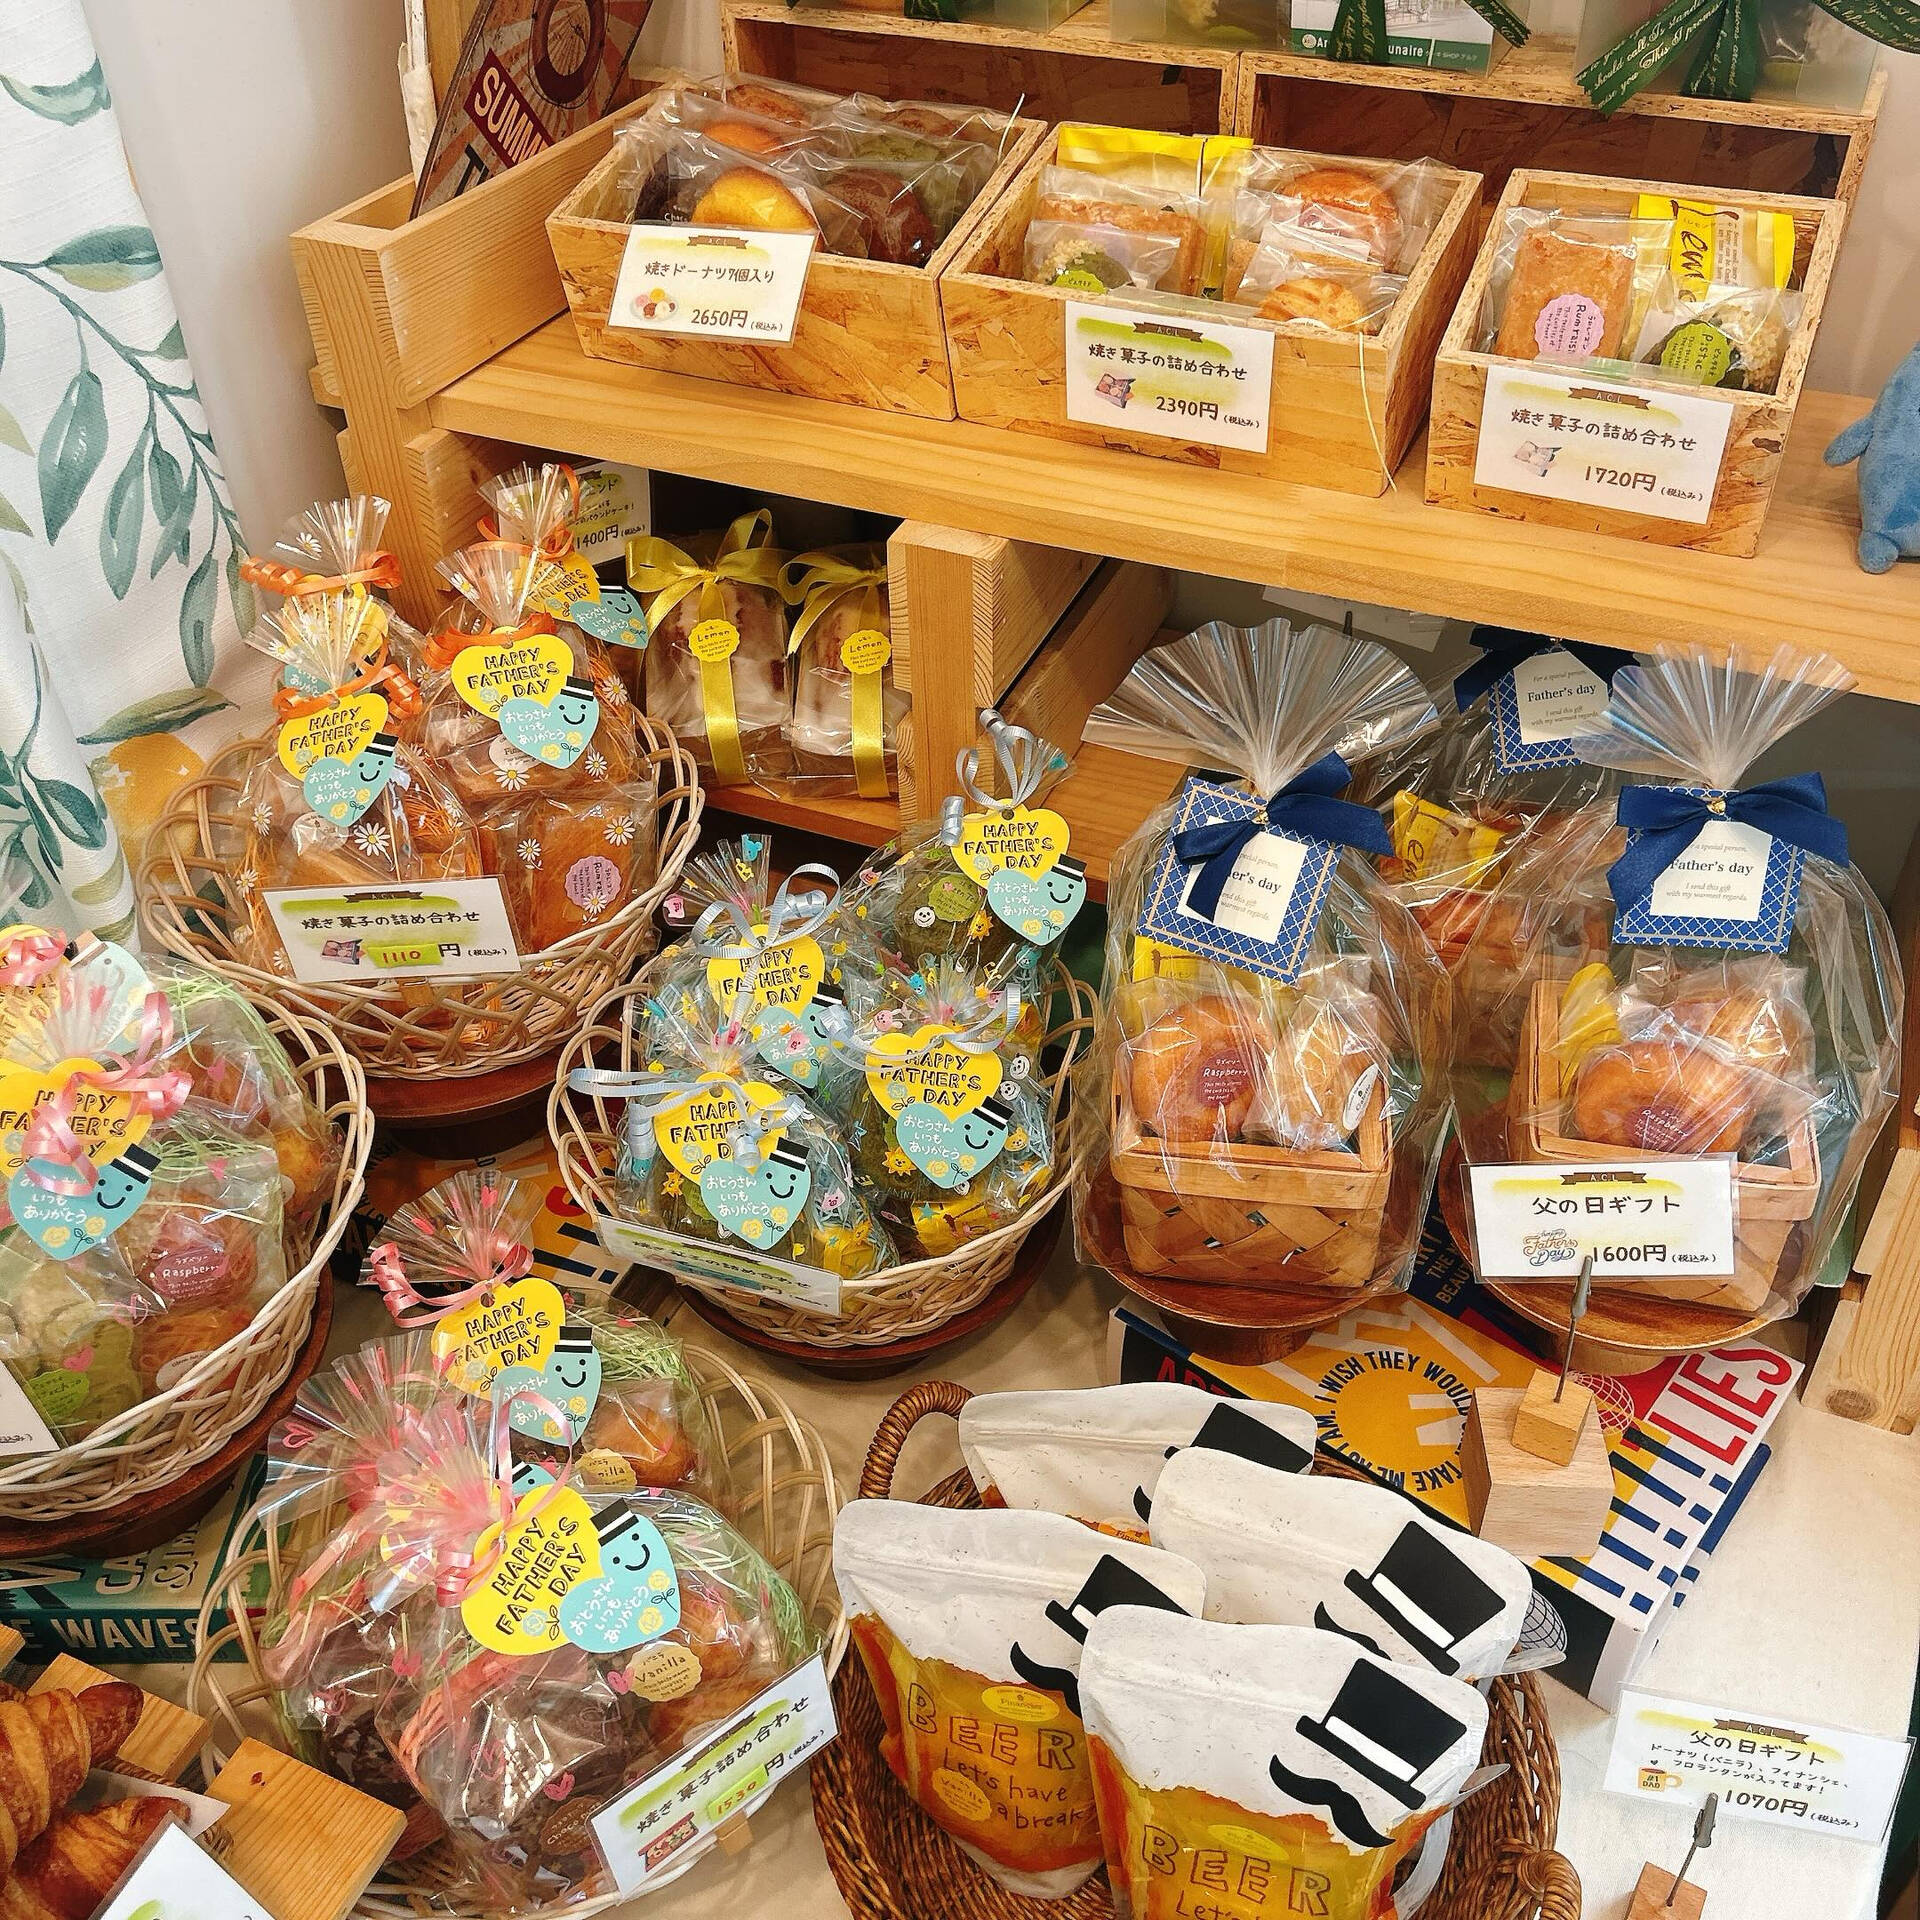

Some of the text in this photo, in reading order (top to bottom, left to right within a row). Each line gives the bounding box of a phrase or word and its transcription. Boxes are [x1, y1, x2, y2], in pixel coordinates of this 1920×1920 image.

[1388, 44, 1424, 57] unaire
[644, 260, 775, 284] 焼きドーナツ7個入り
[690, 308, 749, 328] 2650円
[1088, 343, 1248, 380] 焼き菓子の詰め合わせ
[1155, 396, 1219, 421] 2390円
[1511, 408, 1697, 451] 焼き菓子の詰め合わせ
[1584, 465, 1657, 493] 1720円
[565, 583, 591, 602] DAY
[697, 629, 730, 642] Lemon
[484, 648, 540, 669] HAPPY
[467, 661, 560, 689] FATHER'S
[512, 679, 550, 697] DAY
[1527, 684, 1597, 703] Father's day
[309, 706, 361, 731] HAPPY
[505, 709, 551, 724] おとうさん
[290, 719, 371, 751] FATHER'S
[517, 729, 565, 745] ありがとう
[325, 737, 359, 757] DAY
[309, 768, 351, 784] おとうさん
[314, 787, 357, 805] ありがとう
[983, 822, 1039, 837] HAPPY
[964, 837, 1054, 855] FATHER'S
[1005, 853, 1043, 869] DAY
[1670, 859, 1754, 876] Father's day
[993, 882, 1039, 893] おとうさん
[1258, 878, 1281, 894] day
[302, 910, 481, 930] 焼き菓子の詰め合わせ
[1002, 905, 1049, 917] ありがとう
[382, 949, 422, 964] 1110
[438, 942, 462, 958] 円
[739, 948, 793, 972] HPPY
[766, 985, 802, 1006] DAY
[923, 1088, 967, 1106] DAY
[0, 1110, 126, 1137] FAER'S
[903, 1114, 954, 1132] おとうさん
[909, 1140, 960, 1160] ありがとう
[706, 1176, 757, 1190] おとうさん
[1589, 1173, 1619, 1183] ACL
[23, 1205, 88, 1225] ありがとう
[717, 1203, 770, 1217] ありがとう
[1531, 1195, 1680, 1215] 父の日ギフト
[1592, 1244, 1667, 1263] 1600円
[465, 1297, 526, 1338] HAPPY
[501, 1335, 541, 1367] DAY
[1318, 1356, 1366, 1394] WISH
[1364, 1351, 1421, 1372] THEY
[491, 1517, 546, 1597] HAPPY
[496, 1516, 581, 1636] FATHER'S
[548, 1542, 586, 1597] DAY
[569, 1577, 615, 1637] おとうさん
[604, 1585, 651, 1645] ありがとう
[634, 1656, 687, 1683] Vanilla
[908, 1682, 1075, 1771] BEER
[1689, 1729, 1825, 1766] 父の日ギフト
[636, 1696, 809, 1833] 焼き菓子詰め合わせ
[943, 1747, 1000, 1790] Let's
[1009, 1775, 1068, 1801] have
[717, 1780, 757, 1816] 1530
[765, 1752, 785, 1776] 円
[1642, 1780, 1661, 1790] DAD
[1725, 1789, 1809, 1817] 1070円
[1142, 1824, 1331, 1917] BEER
